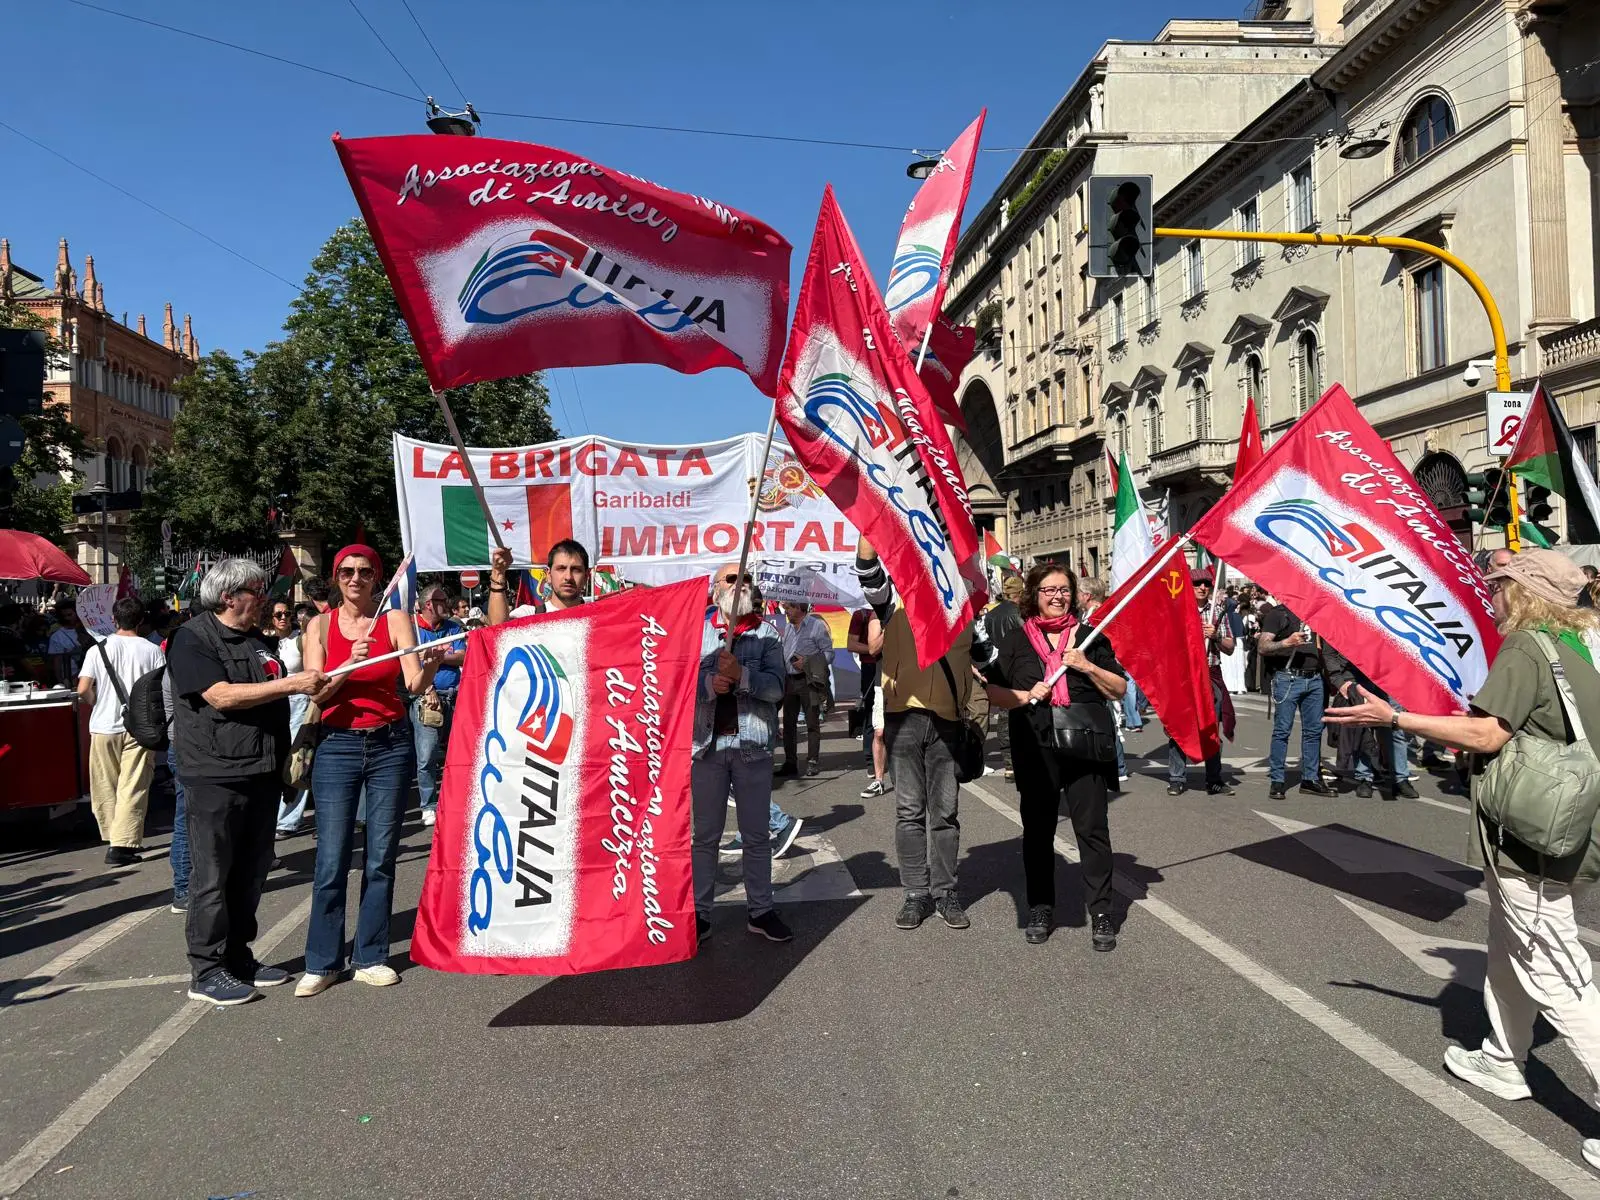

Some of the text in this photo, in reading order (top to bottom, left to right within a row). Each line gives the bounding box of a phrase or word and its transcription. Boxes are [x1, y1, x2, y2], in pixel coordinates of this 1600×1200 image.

[469, 178, 515, 206] di
[1503, 400, 1521, 408] zona
[413, 443, 713, 480] LA BRIGATA
[594, 491, 691, 509] Garibaldi
[1341, 473, 1382, 495] di
[1375, 498, 1495, 619] Amicizia
[1360, 553, 1474, 660] ITALIA
[636, 613, 668, 784] Associazione
[515, 757, 560, 908] ITALIA
[601, 667, 643, 901] di Amicizia
